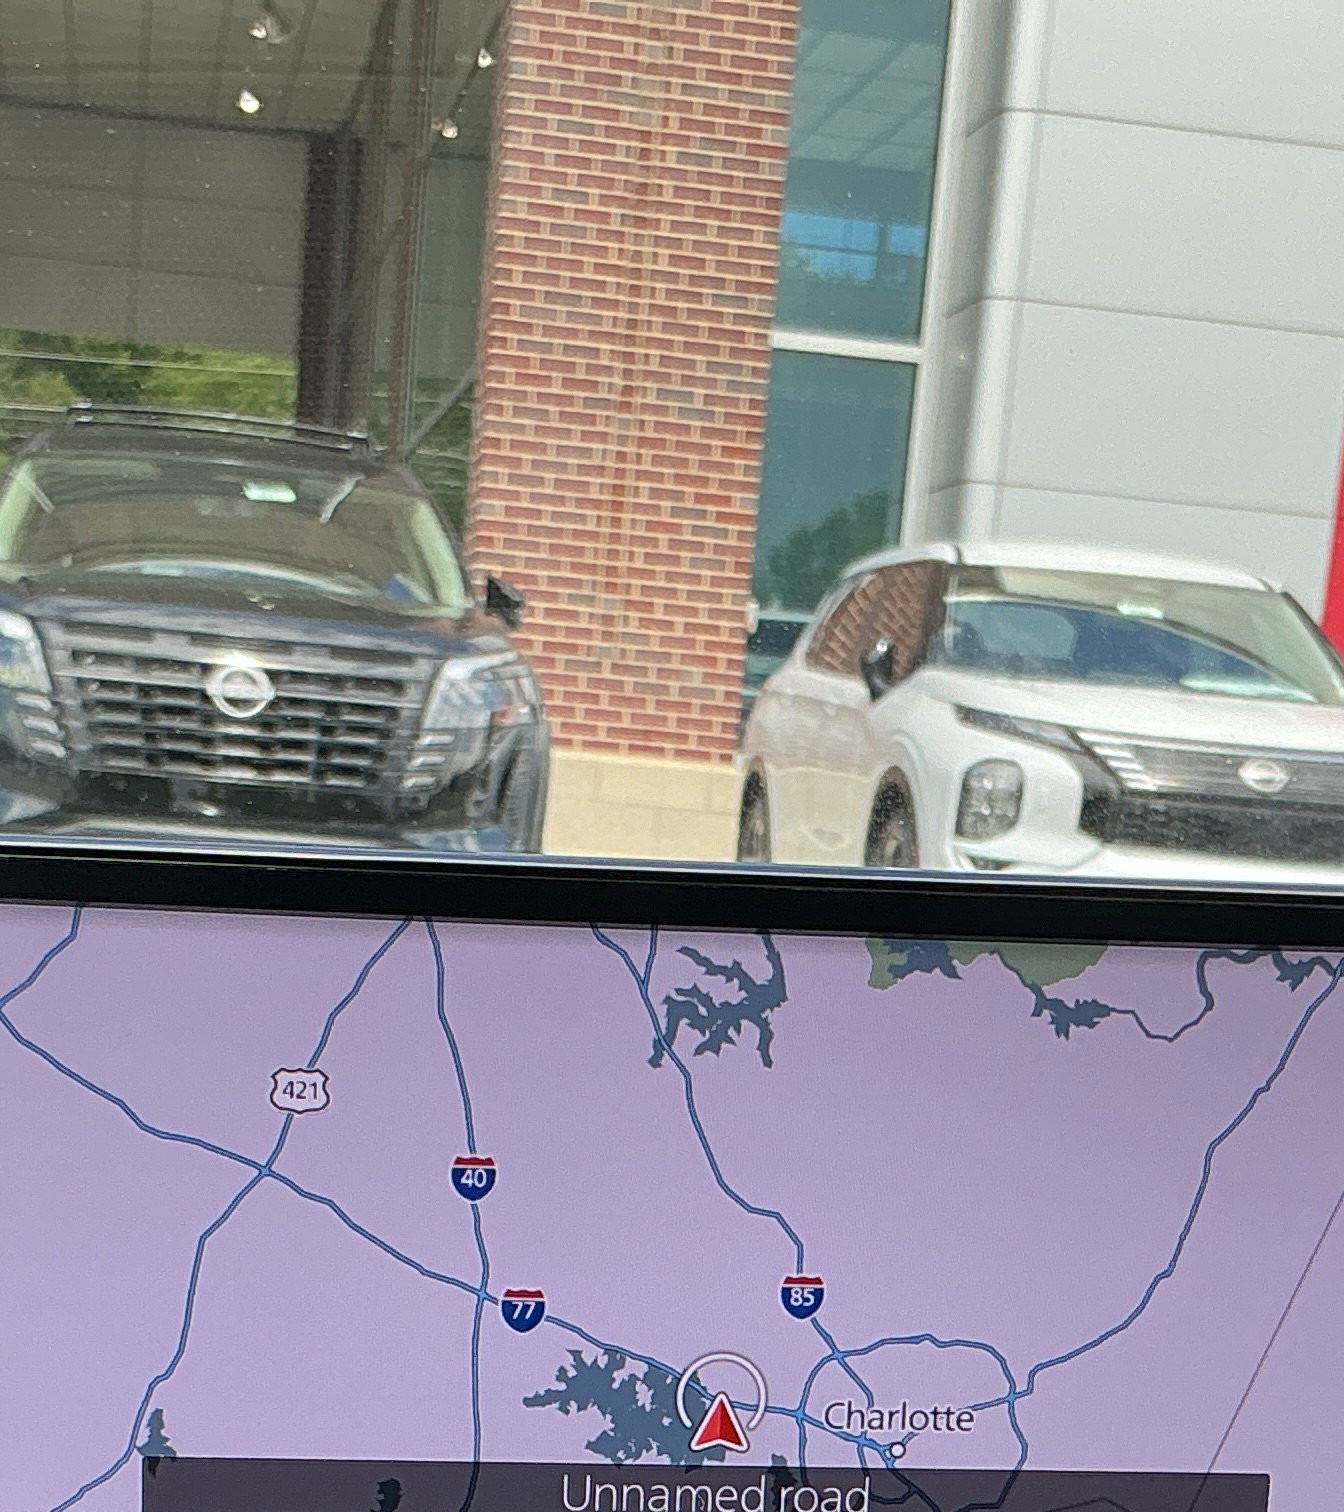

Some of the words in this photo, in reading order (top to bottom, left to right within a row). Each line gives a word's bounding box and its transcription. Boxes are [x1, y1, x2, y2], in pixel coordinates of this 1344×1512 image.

[281, 1079, 319, 1101] 421
[460, 1168, 487, 1188] 40
[789, 1287, 815, 1307] 85
[510, 1301, 536, 1320] 77
[824, 1400, 975, 1432] Charlotte
